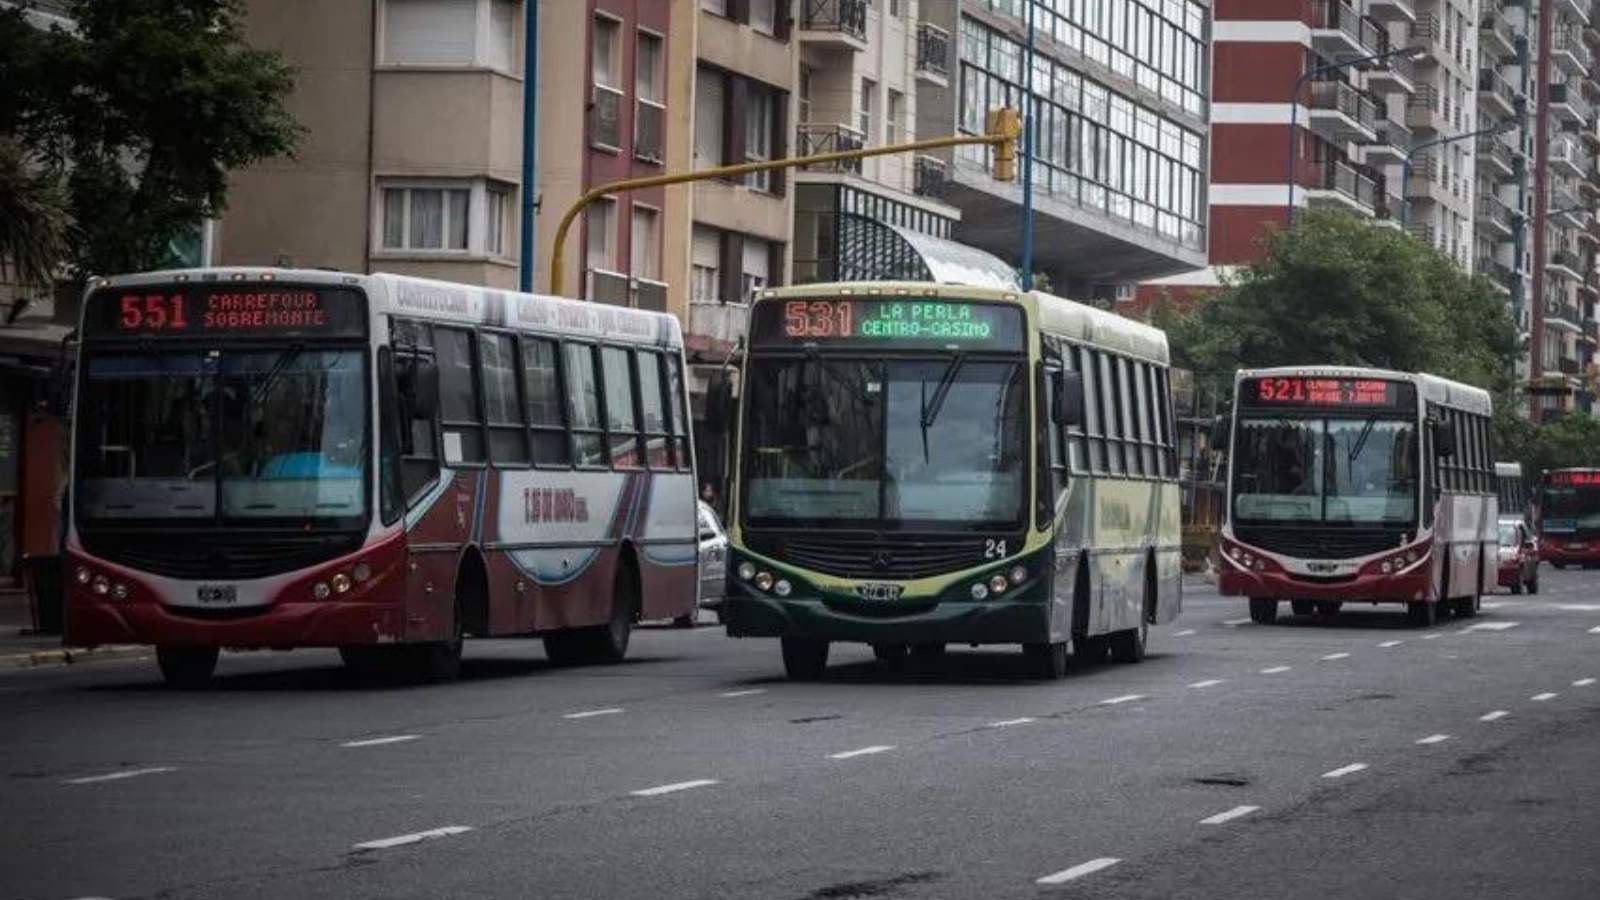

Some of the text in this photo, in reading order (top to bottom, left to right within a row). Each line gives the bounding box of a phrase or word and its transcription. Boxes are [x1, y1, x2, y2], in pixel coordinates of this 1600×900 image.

[208, 294, 317, 308] CARREFOUR
[120, 295, 188, 329] 551
[204, 311, 325, 327] SOBREMONTE
[785, 301, 853, 337] 531
[880, 305, 971, 319] LA PERLA
[862, 320, 991, 337] CENTRO-CASINO
[1260, 379, 1305, 401] 521
[985, 538, 1007, 558] 24
